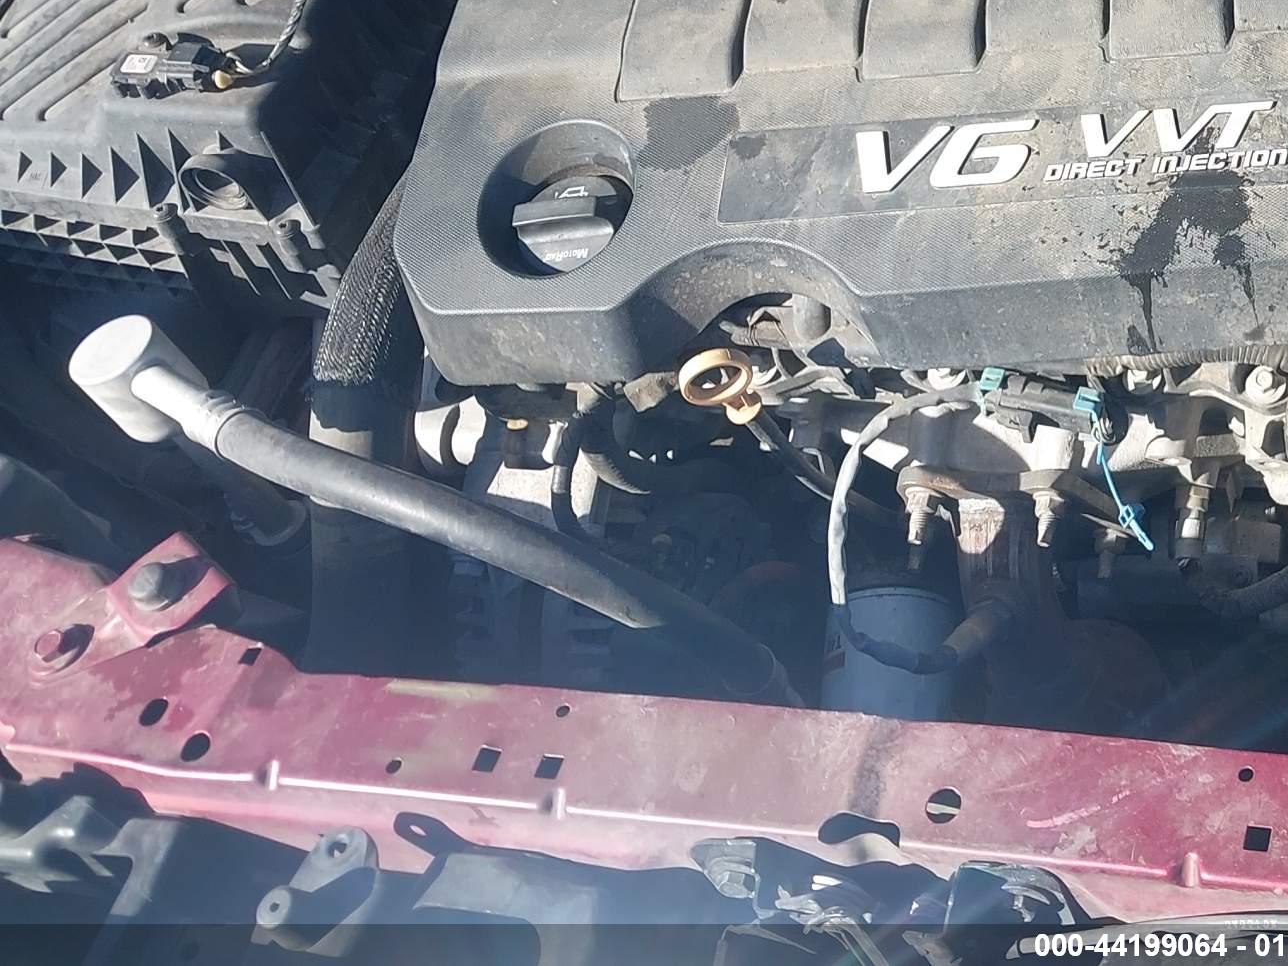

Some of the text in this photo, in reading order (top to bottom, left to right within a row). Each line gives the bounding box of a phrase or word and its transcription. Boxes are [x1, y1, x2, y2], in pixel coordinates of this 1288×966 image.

[855, 100, 1277, 194] V6 VVT
[1043, 155, 1148, 183] DIRECT
